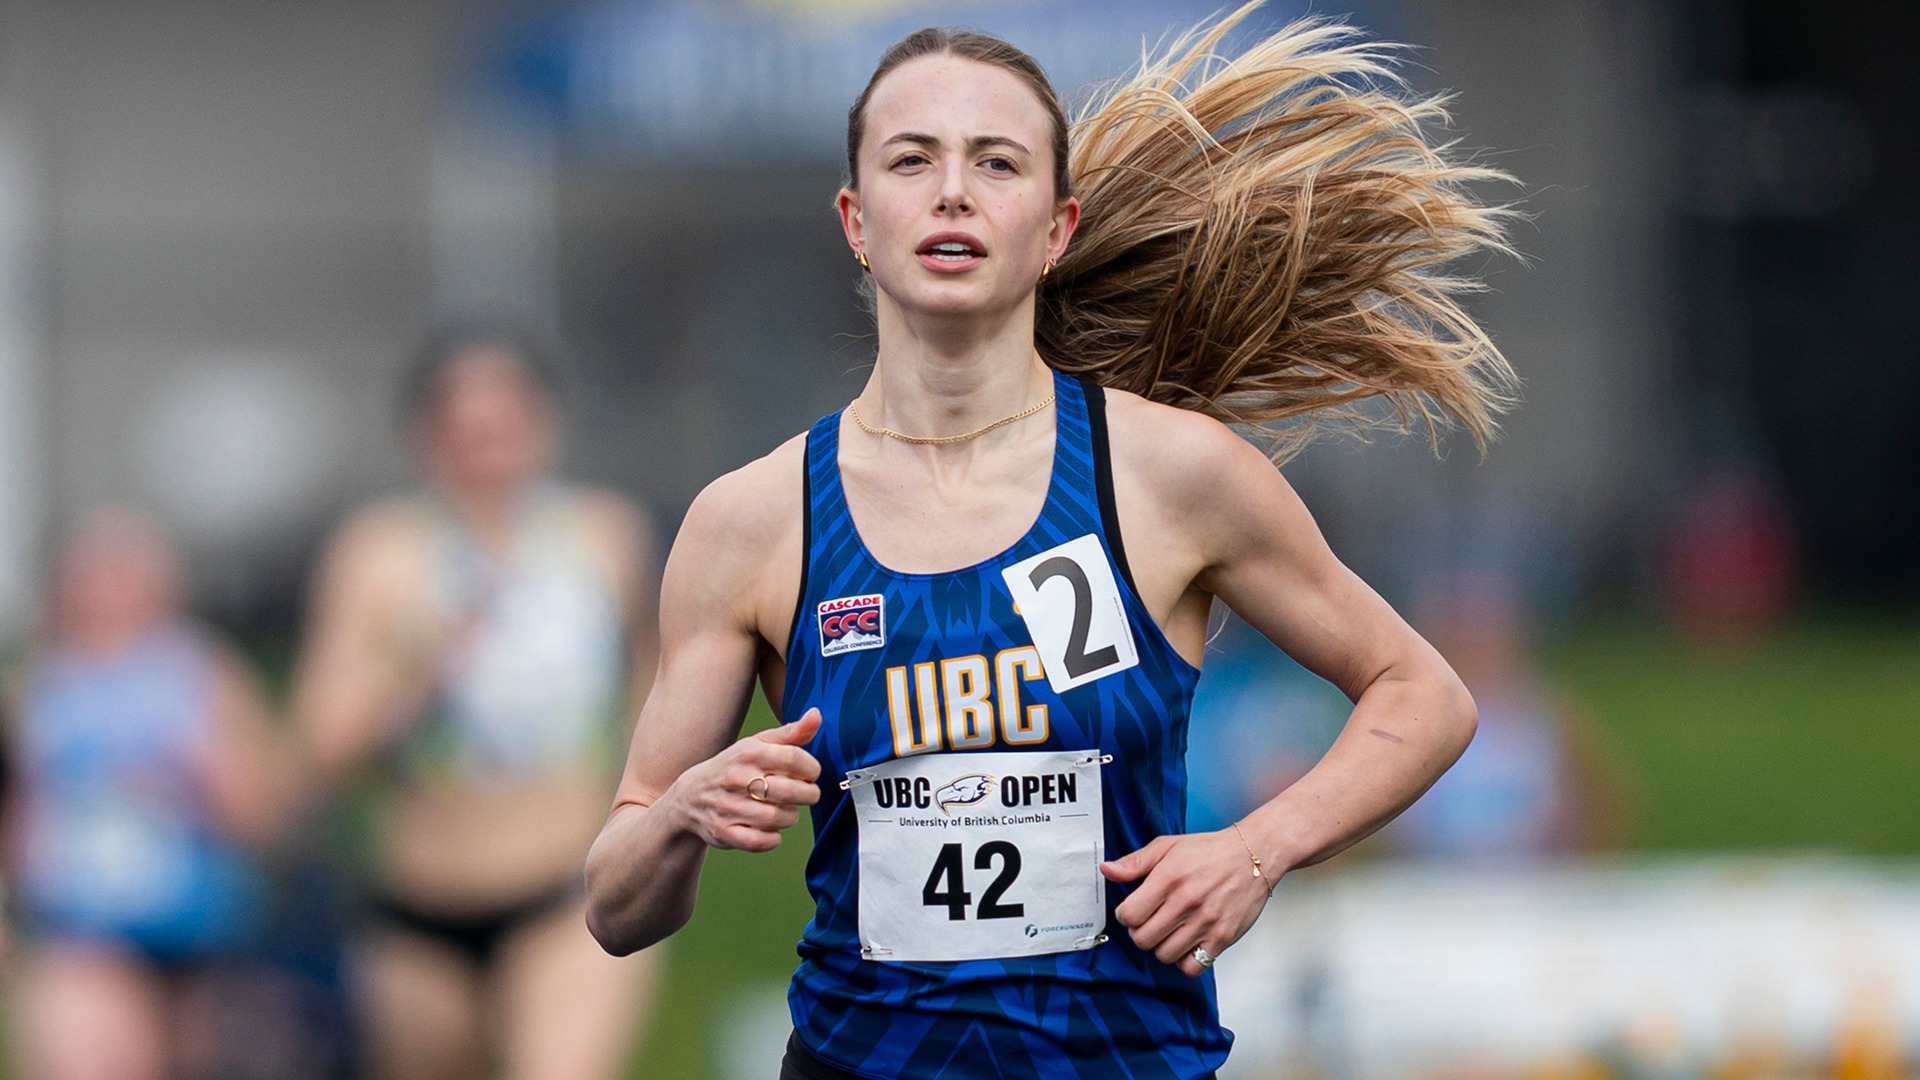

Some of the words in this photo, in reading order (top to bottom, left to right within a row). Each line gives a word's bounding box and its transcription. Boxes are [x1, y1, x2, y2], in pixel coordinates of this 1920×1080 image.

[820, 597, 880, 612] CASCADE
[1028, 556, 1120, 680] 2
[823, 610, 878, 637] CCC
[886, 645, 1049, 759] UBC
[873, 777, 931, 809] UBC
[1001, 772, 1077, 807] OPEN
[900, 817, 948, 829] University
[951, 817, 961, 826] of
[964, 816, 999, 827] British
[1002, 813, 1051, 826] Columbia
[922, 840, 1024, 921] 42
[1041, 922, 1095, 933] FORERUNNERS
